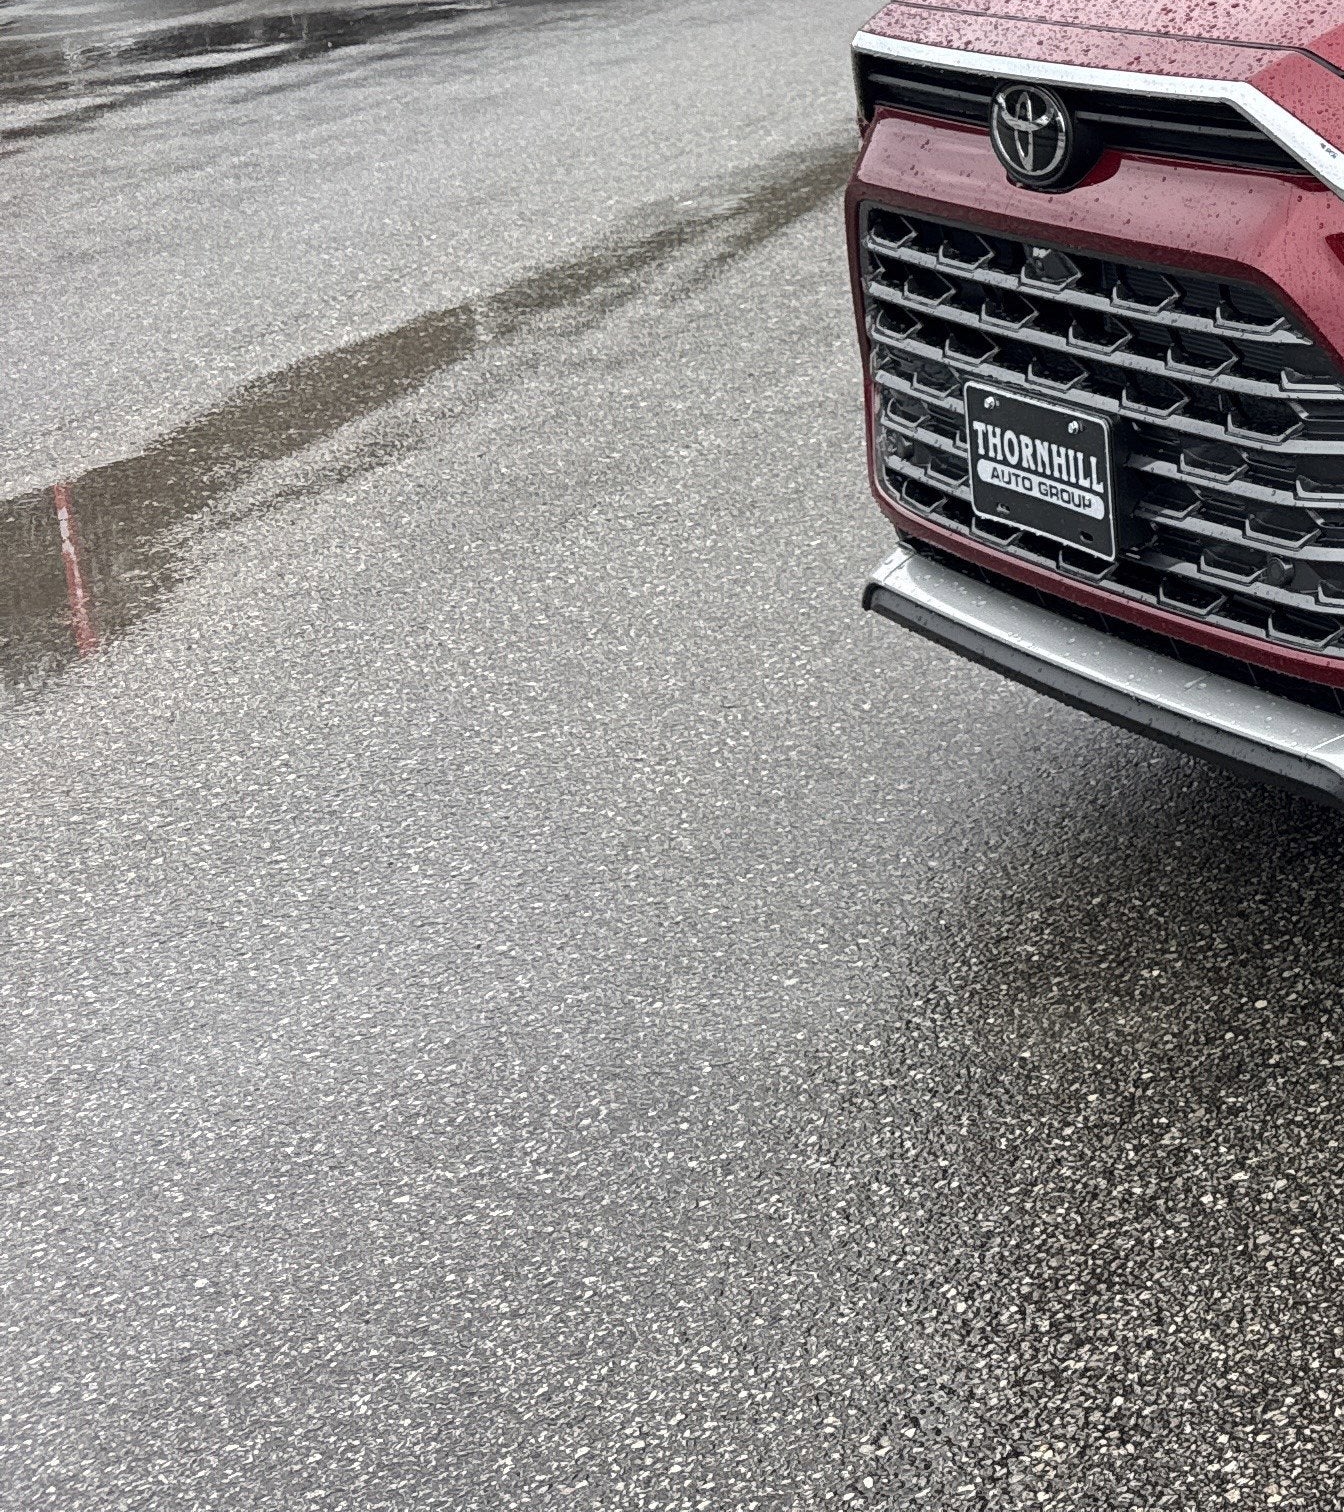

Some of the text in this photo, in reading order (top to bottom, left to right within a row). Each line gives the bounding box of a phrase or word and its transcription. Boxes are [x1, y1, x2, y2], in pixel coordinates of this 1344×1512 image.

[972, 420, 1104, 494] THORNHILL
[990, 466, 1092, 510] AUTO GROUP
